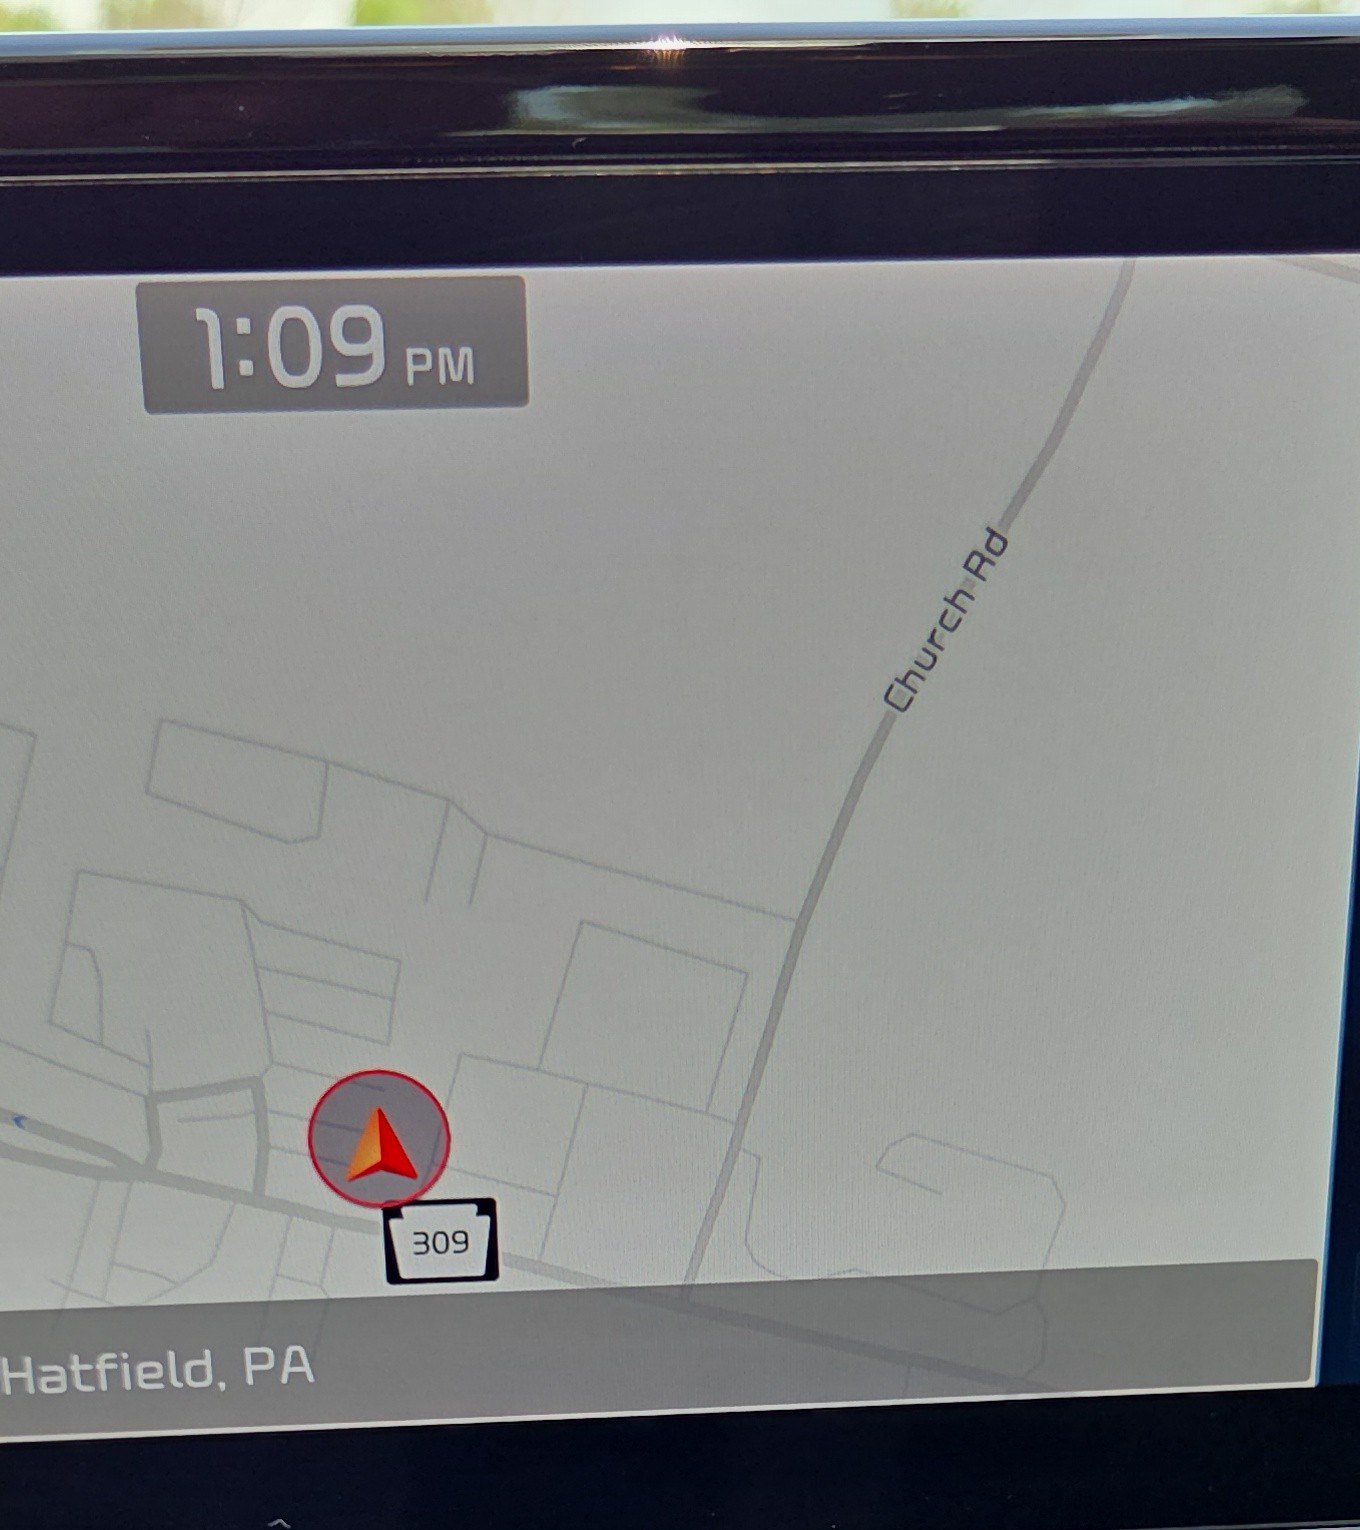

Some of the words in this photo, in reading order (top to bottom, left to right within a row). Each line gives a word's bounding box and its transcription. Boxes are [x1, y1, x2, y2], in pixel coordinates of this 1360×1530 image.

[195, 304, 385, 390] 1:09
[405, 345, 475, 386] PM
[883, 588, 976, 713] Church
[962, 525, 1009, 582] Rd
[412, 1229, 470, 1256] 309
[243, 1344, 315, 1386] PA
